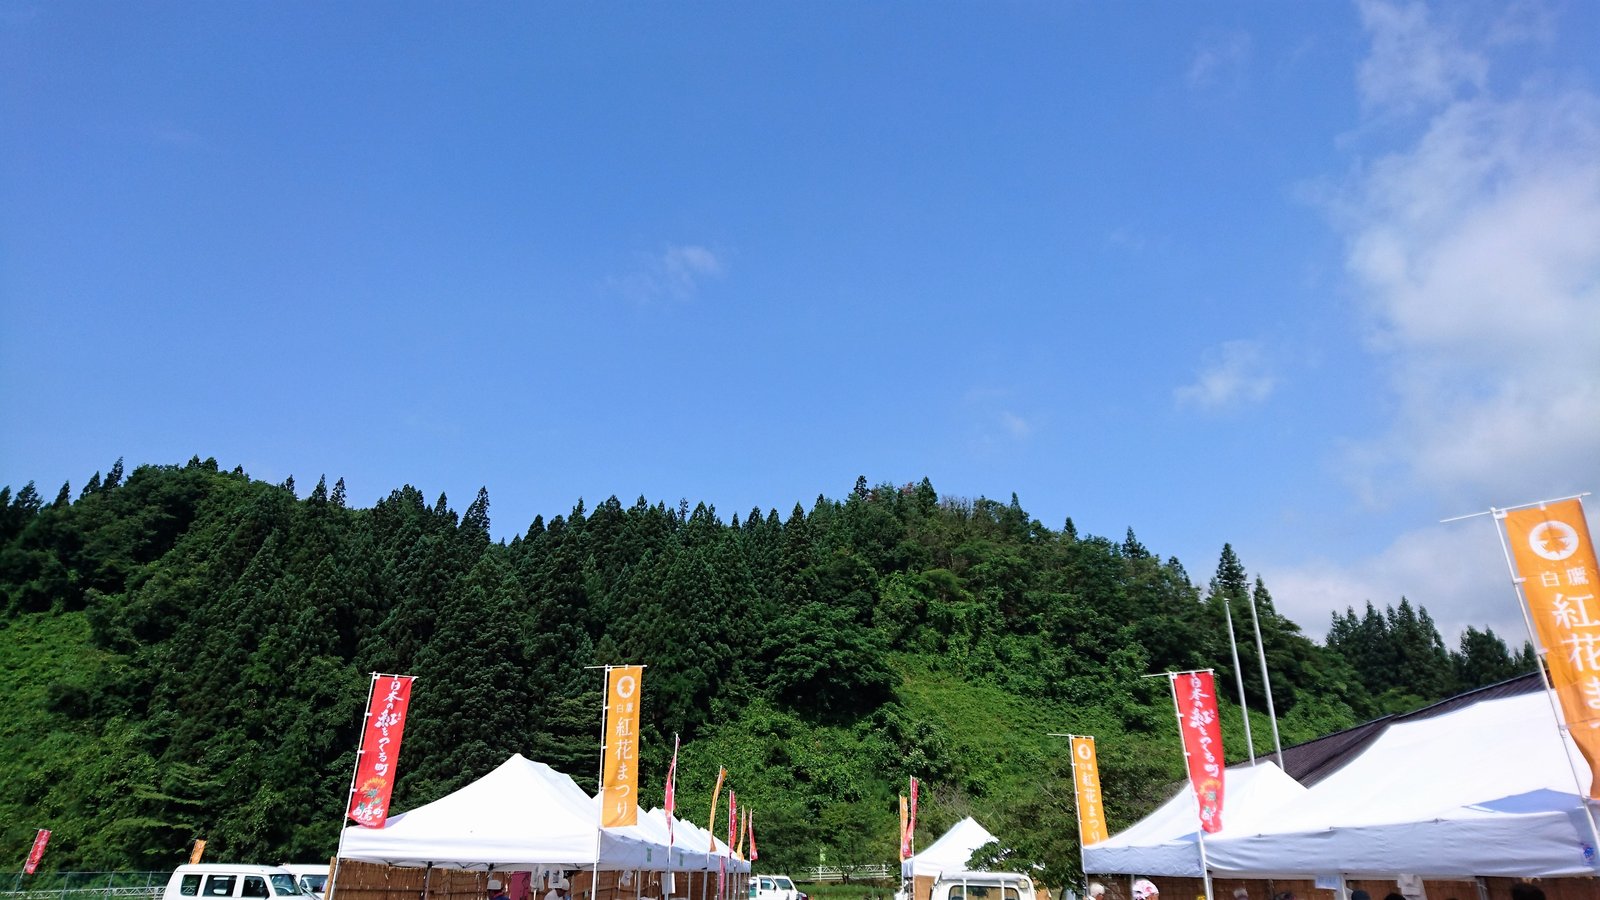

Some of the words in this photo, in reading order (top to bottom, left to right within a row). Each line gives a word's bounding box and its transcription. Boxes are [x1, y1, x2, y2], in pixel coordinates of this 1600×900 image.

[1541, 566, 1590, 587] 白鷹
[614, 716, 634, 820] 紅花まつり
